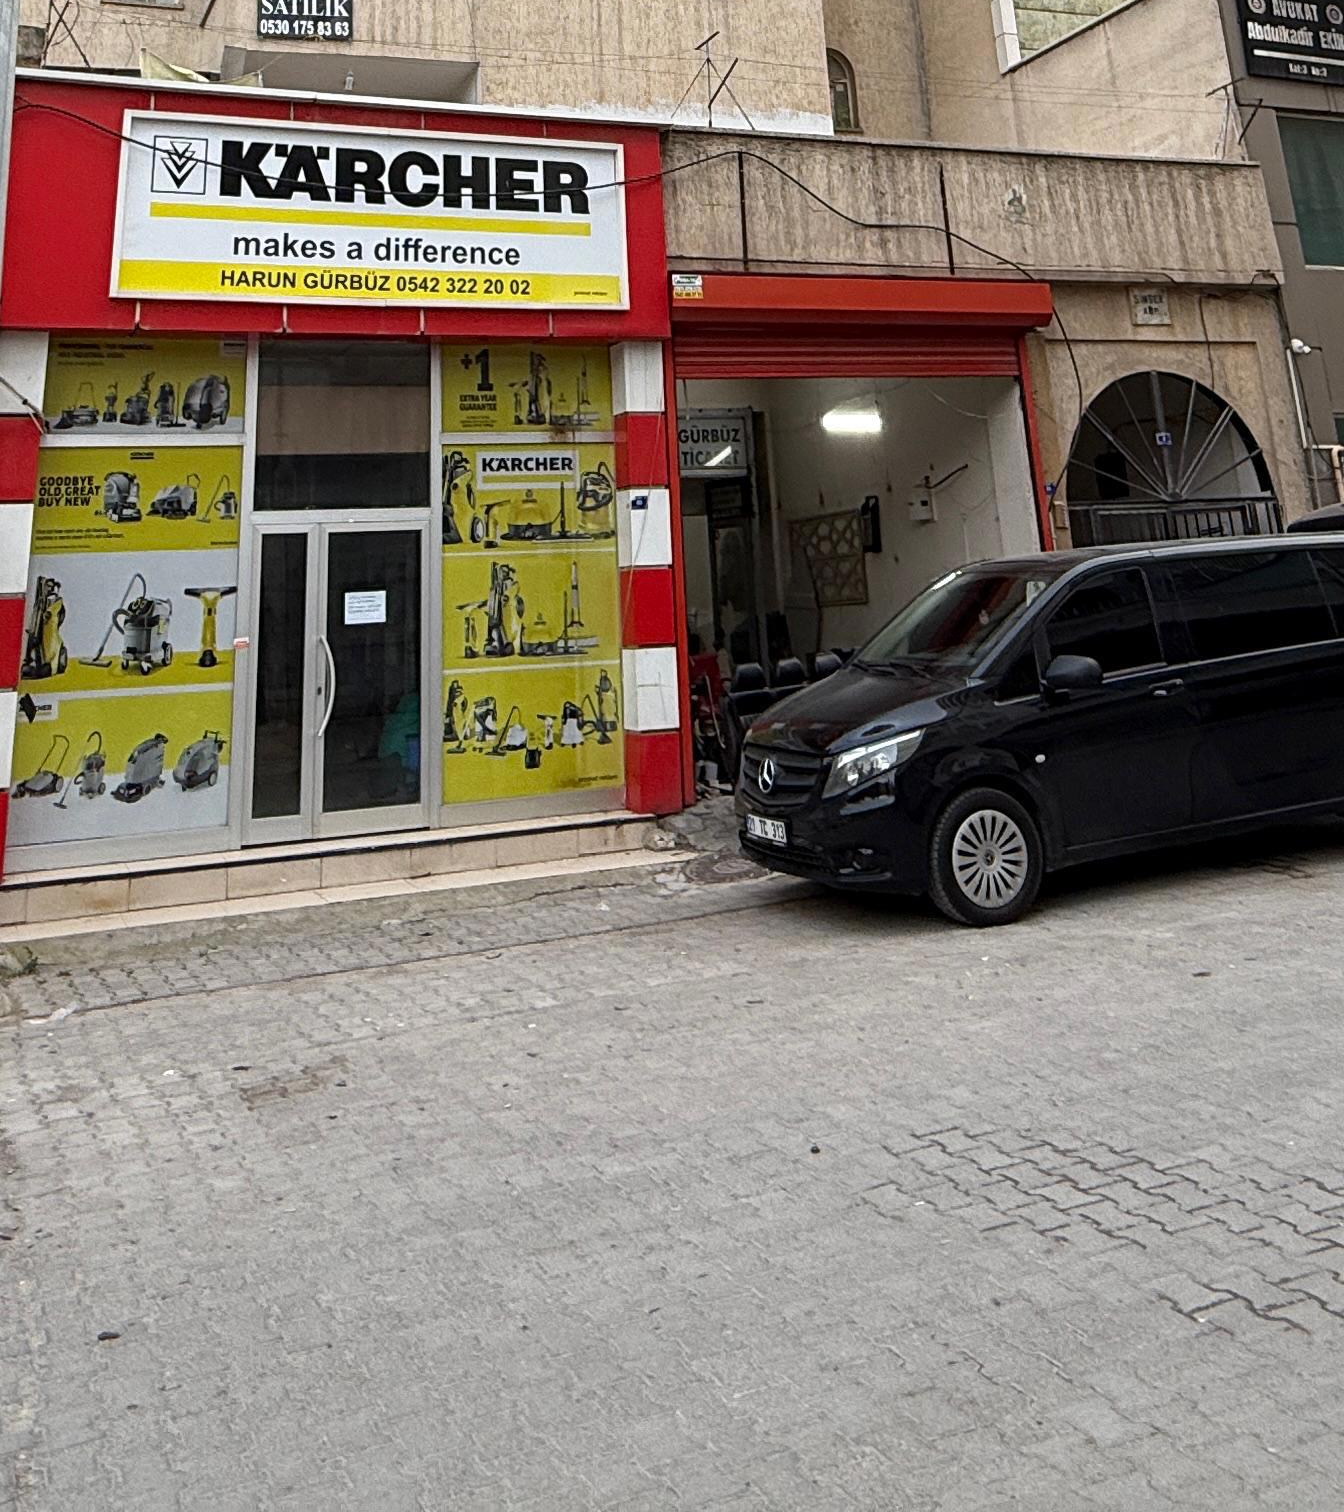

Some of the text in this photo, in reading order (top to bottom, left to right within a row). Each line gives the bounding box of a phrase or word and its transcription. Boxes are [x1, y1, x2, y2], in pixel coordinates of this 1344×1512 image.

[260, 19, 350, 36] 0530 175 83 63
[219, 139, 591, 215] KÄRCHER
[232, 232, 522, 267] makes a difference
[220, 269, 531, 296] HARUN GÜRBÜZ 0542 322 20 02
[678, 424, 741, 444] GÜRBÜZ
[481, 457, 574, 472] KÄRCHER
[39, 475, 94, 487] GOODBYE
[64, 485, 101, 496] GREAT
[38, 496, 91, 507] BUY NEW
